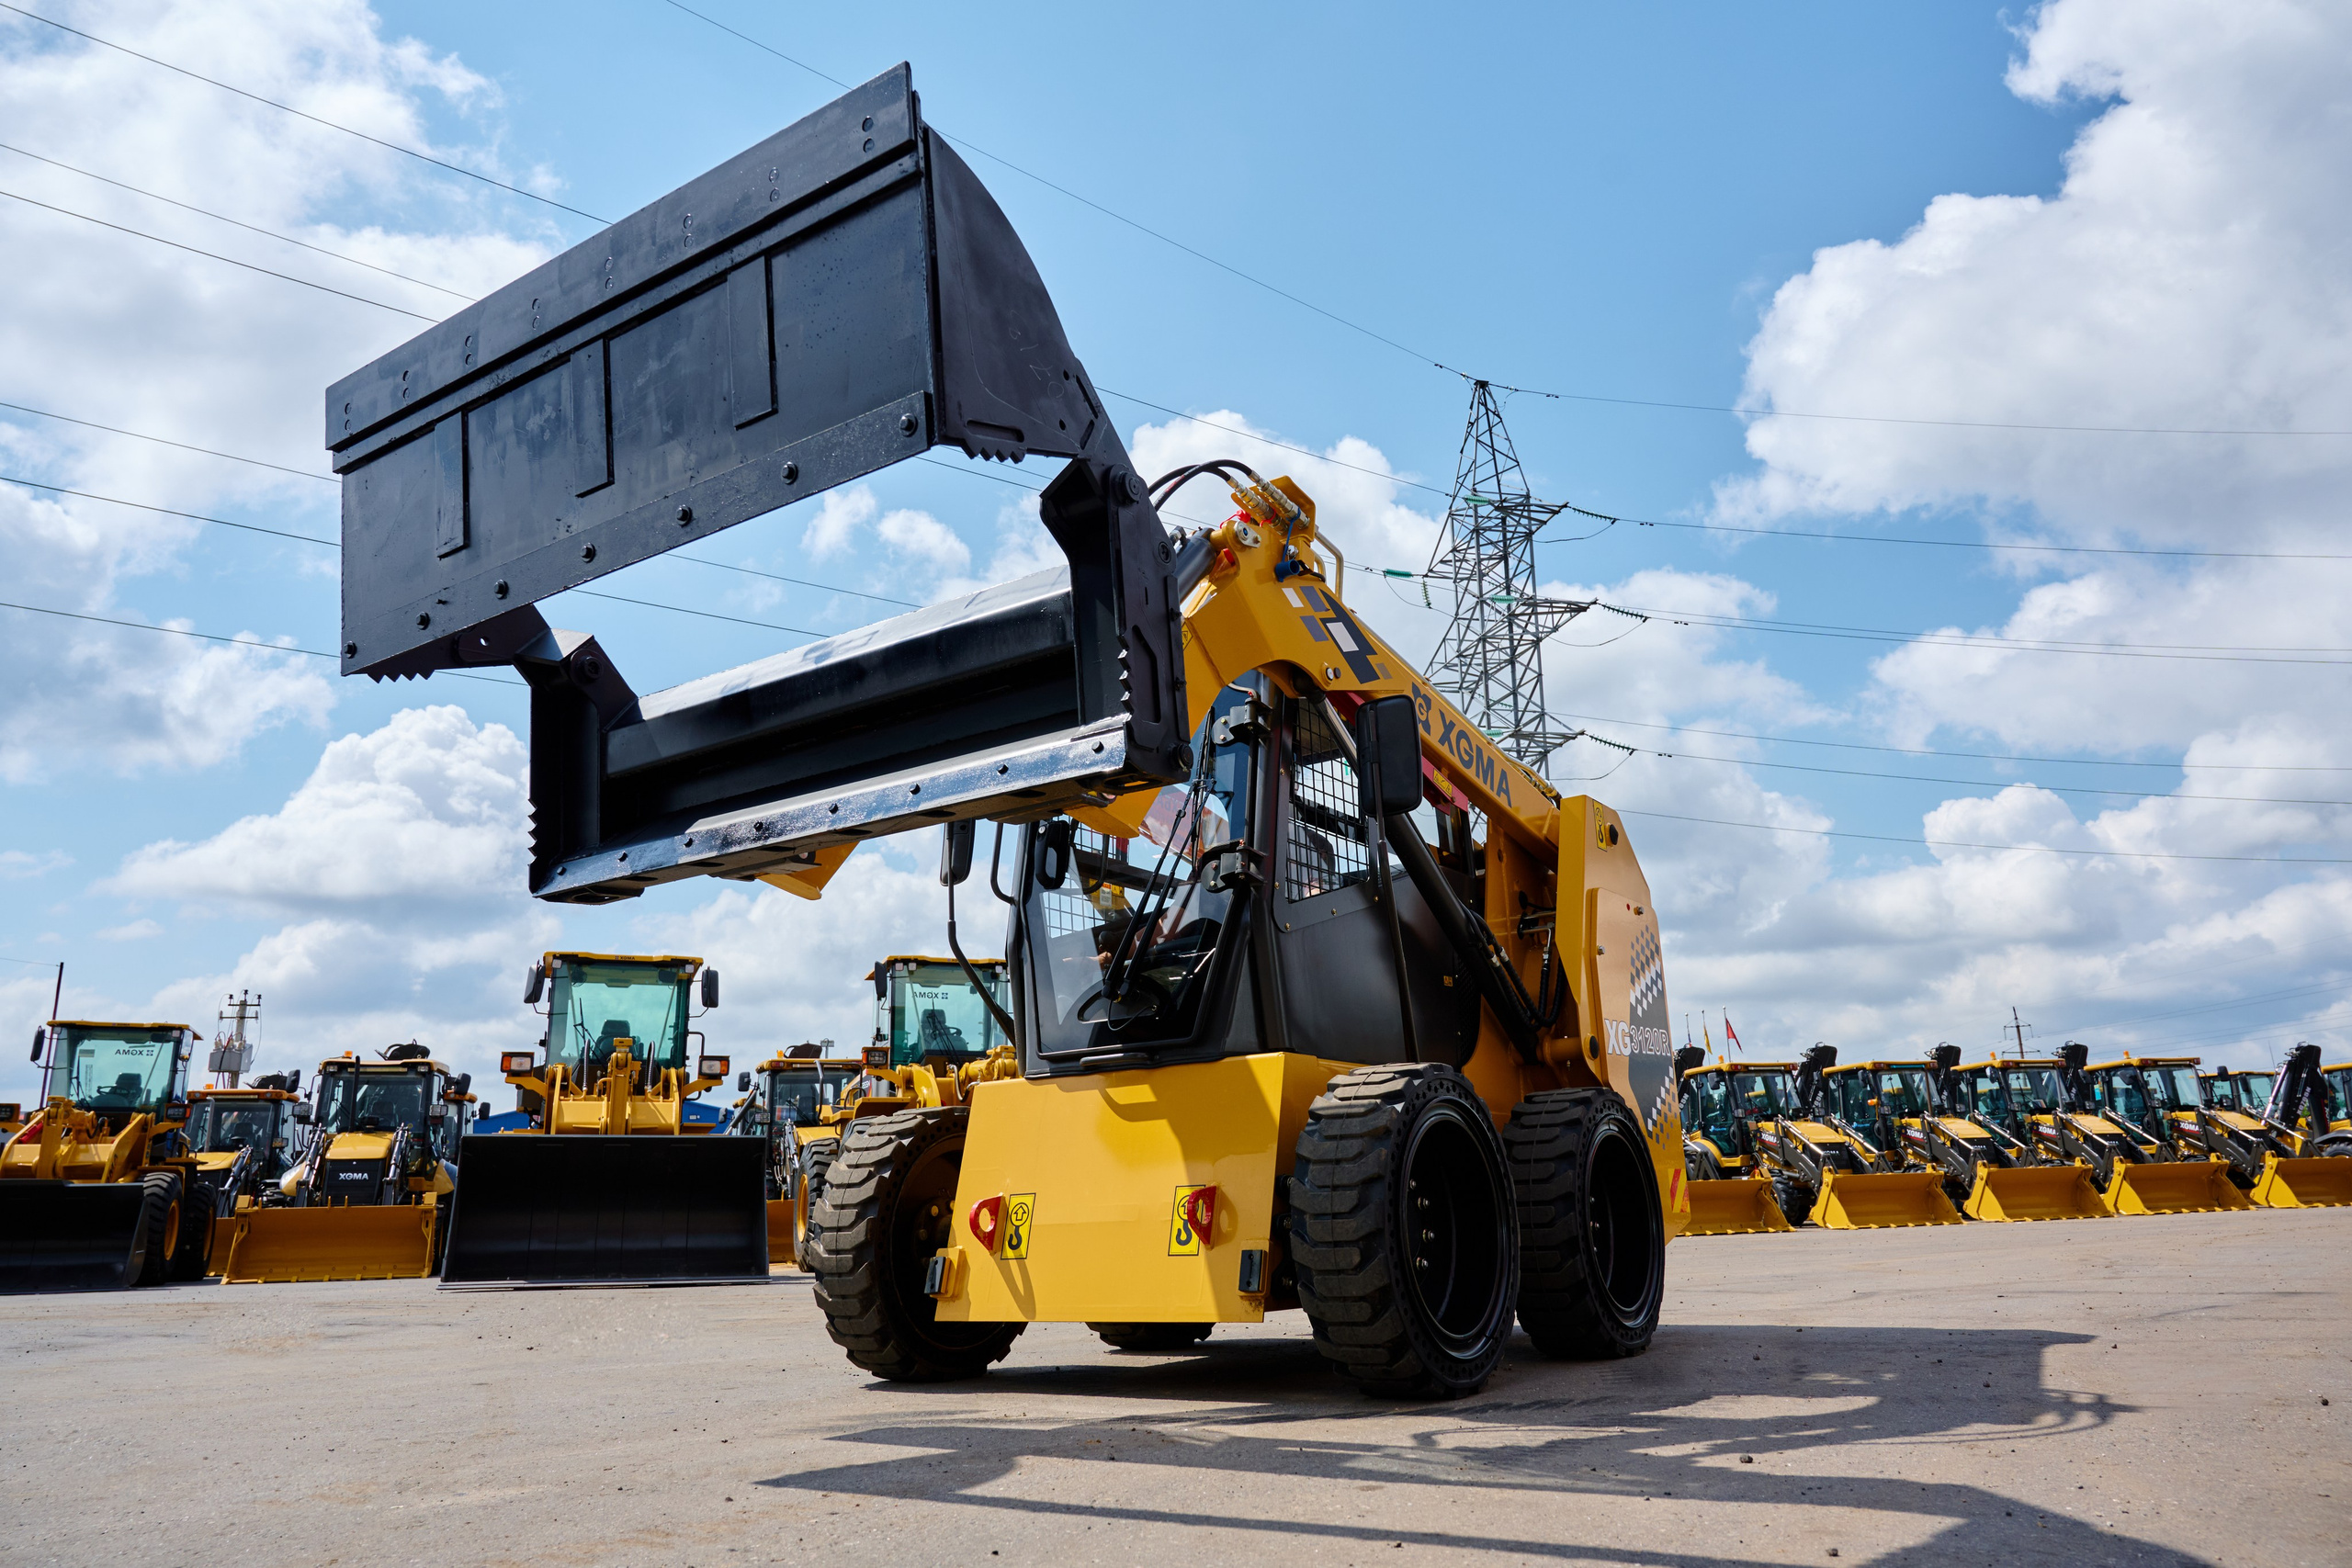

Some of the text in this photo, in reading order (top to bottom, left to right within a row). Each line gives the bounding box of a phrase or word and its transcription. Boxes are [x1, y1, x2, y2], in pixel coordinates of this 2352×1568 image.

[1437, 708, 1512, 808] XGMA
[1604, 1019, 1671, 1056] XG3120R
[2179, 1122, 2199, 1132] XGMA
[339, 1172, 369, 1180] XGMA
